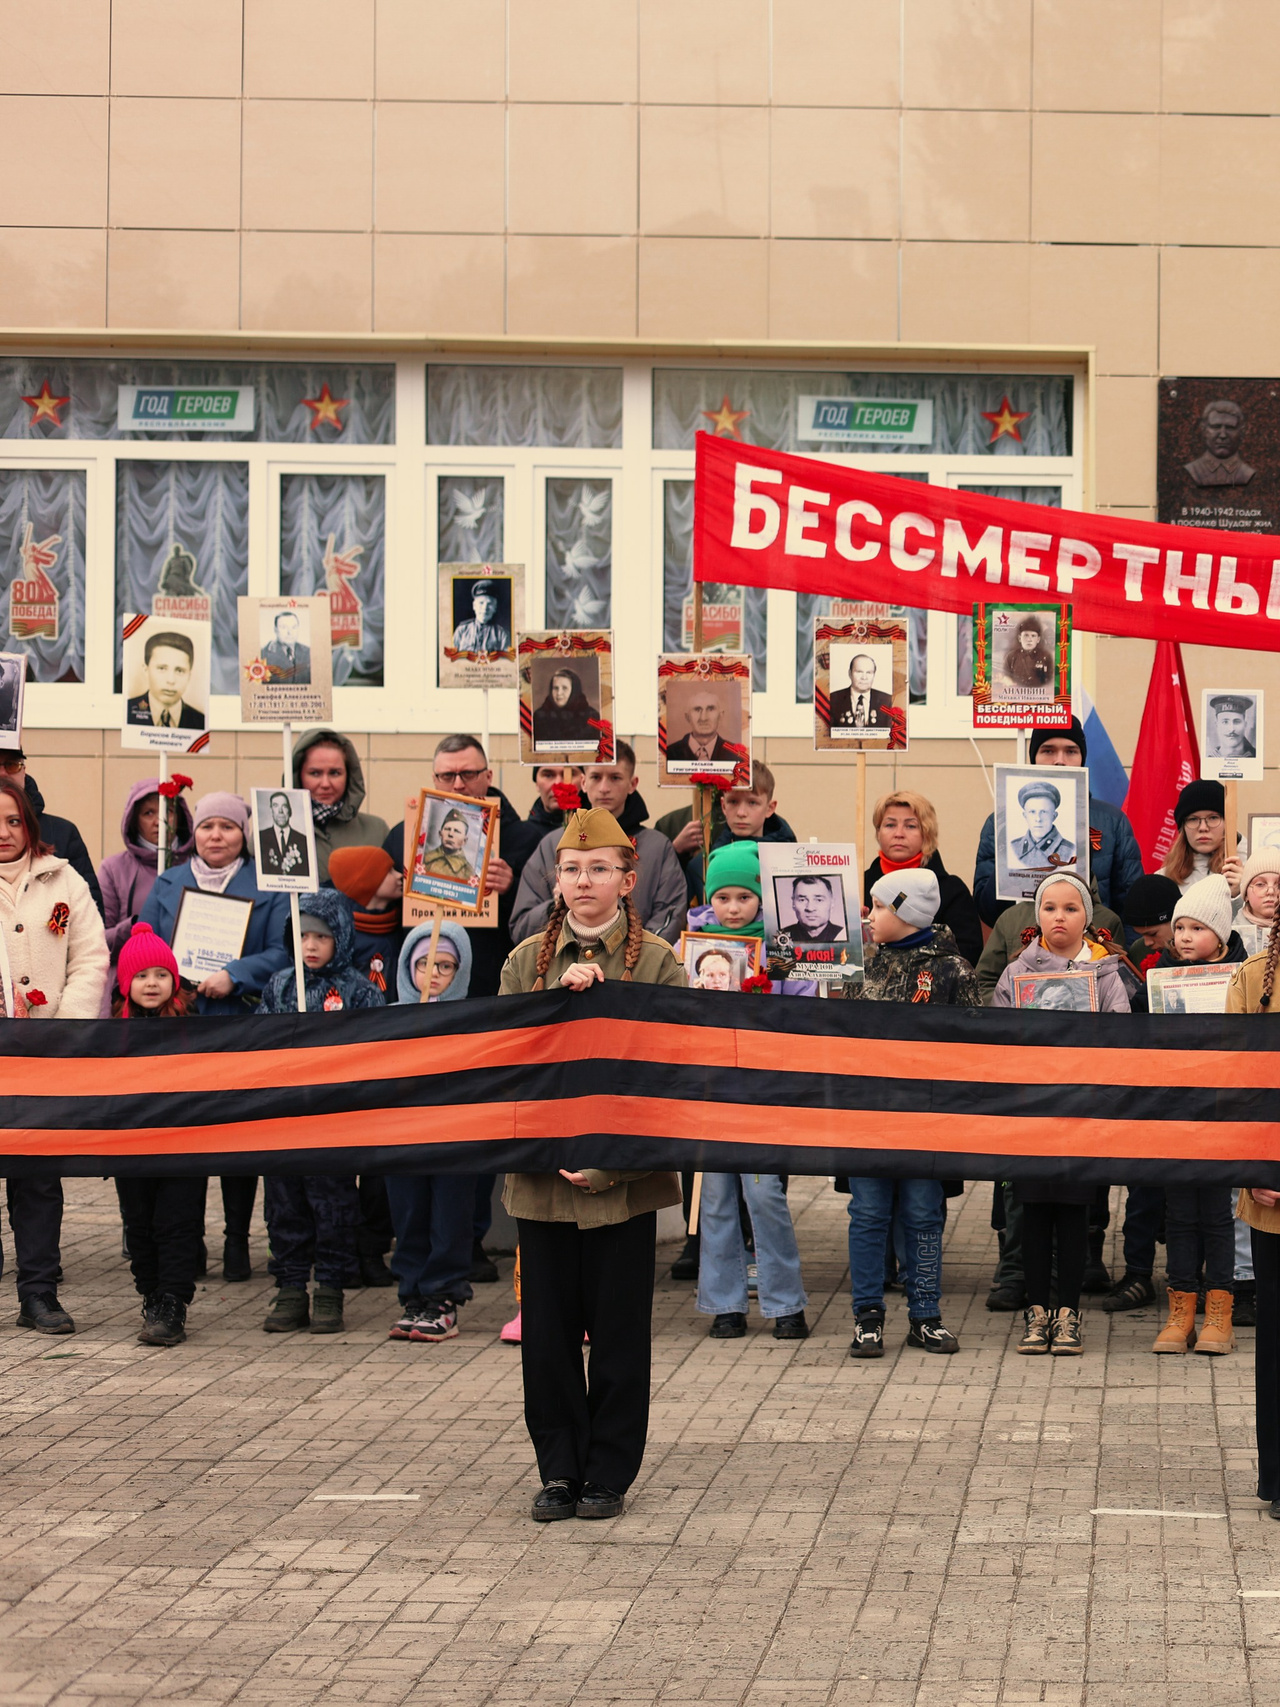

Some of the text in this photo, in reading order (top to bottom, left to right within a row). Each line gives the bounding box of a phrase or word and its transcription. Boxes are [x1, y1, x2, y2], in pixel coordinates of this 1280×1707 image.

[139, 395, 232, 415] ГОД ГЕРОЕВ
[819, 405, 911, 426] ГОД ГЕРОЕВ
[1182, 507, 1262, 517] В 1940-1942 годах
[1177, 519, 1217, 527] поселке
[12, 580, 37, 602] 80
[154, 598, 210, 612] СПАСИБО
[12, 605, 57, 620] ПОБЕДА!
[685, 605, 741, 620] САСИБО!
[977, 704, 1067, 715] БЕССМЕРТНЫЙ,
[976, 715, 1068, 725] ПОБЕДНЫЙ ПОЛК!
[806, 854, 850, 866] ПОБЕДЫ!
[794, 946, 835, 962] 9 мая!
